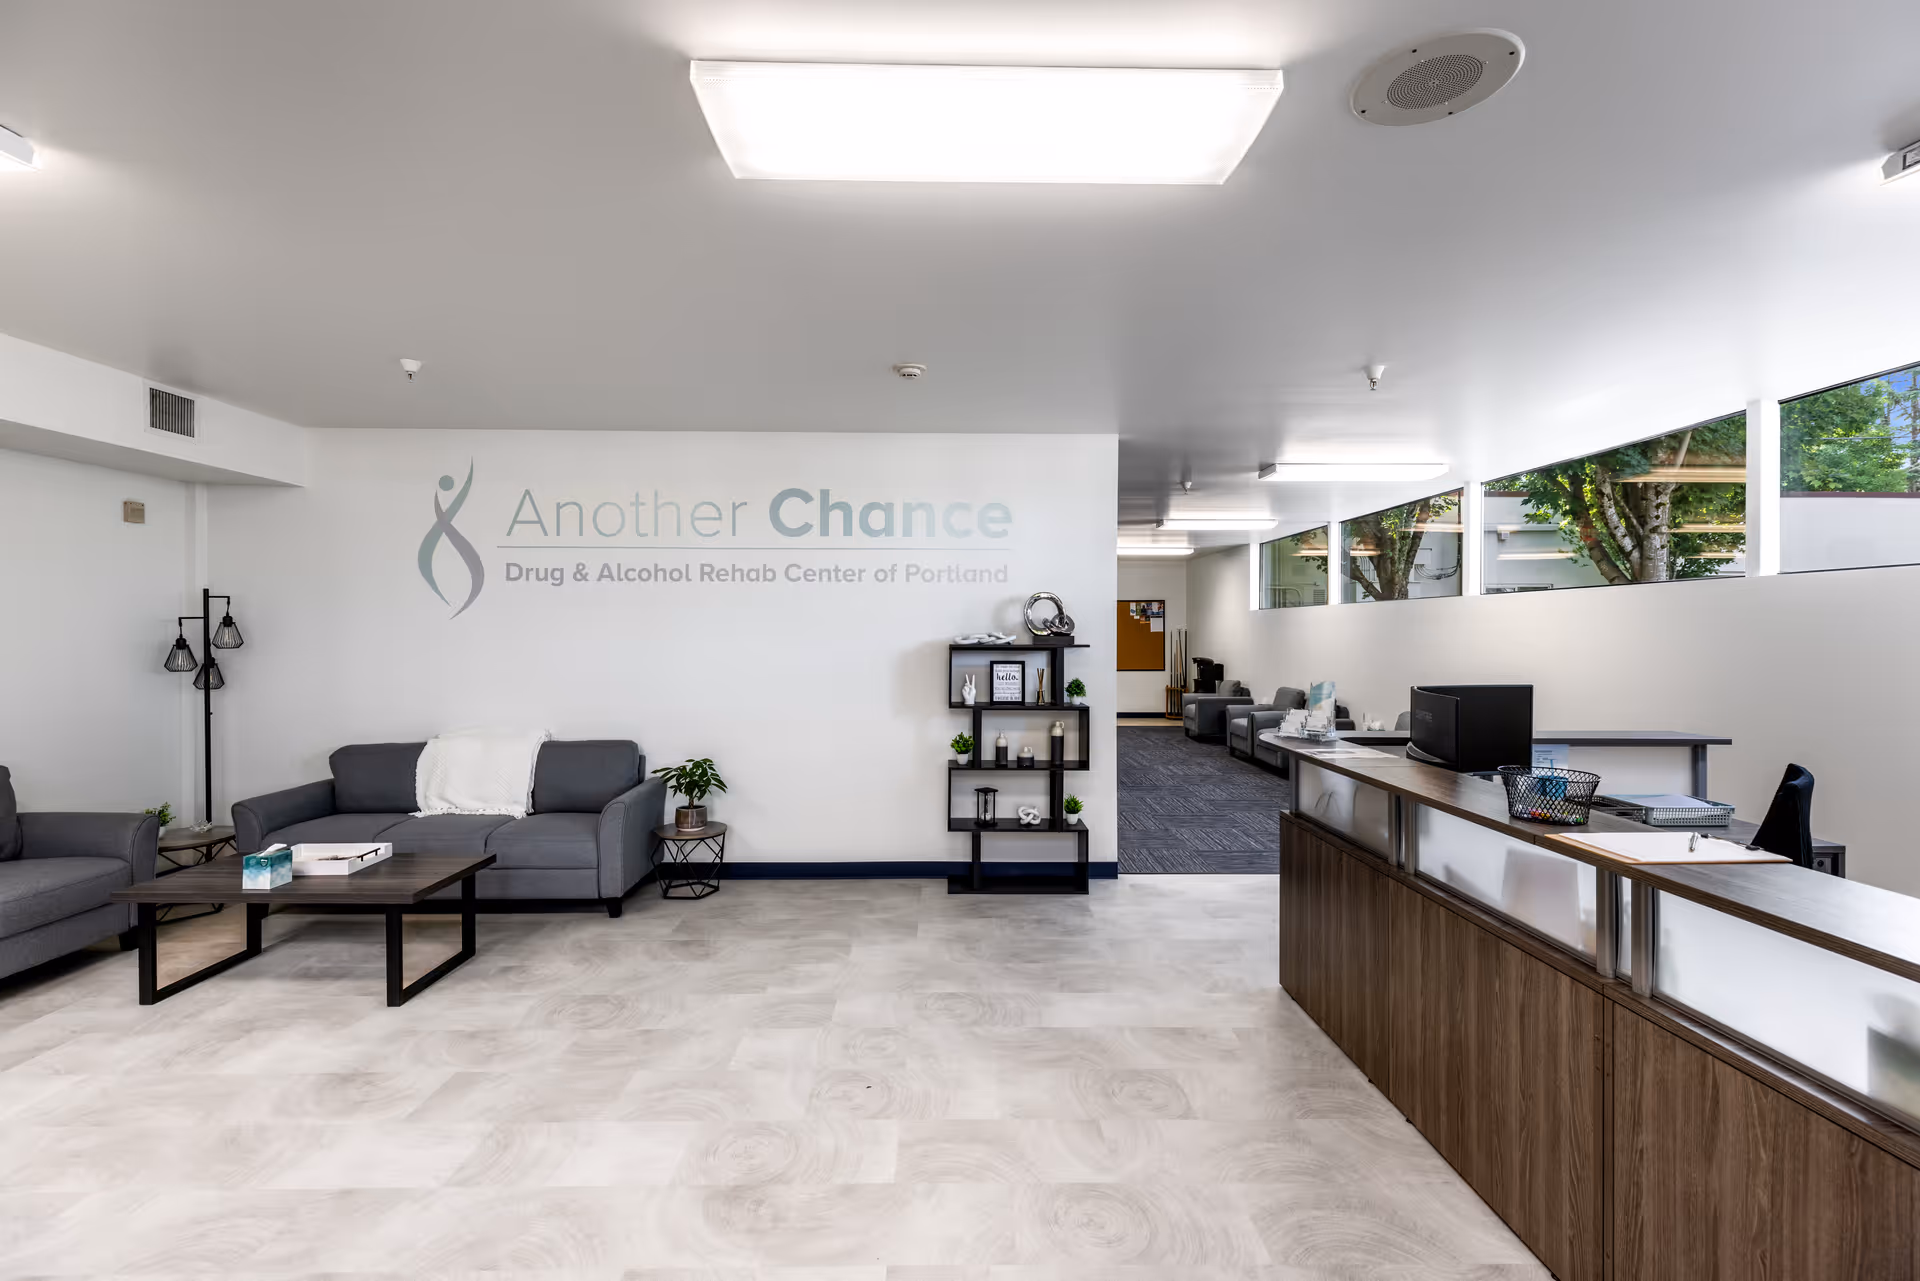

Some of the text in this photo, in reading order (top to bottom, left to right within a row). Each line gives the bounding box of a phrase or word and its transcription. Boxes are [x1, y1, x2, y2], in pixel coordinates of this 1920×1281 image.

[506, 487, 1013, 538] Another Chance
[505, 562, 1009, 587] Drug & Alcohol Rehab Center of Portland
